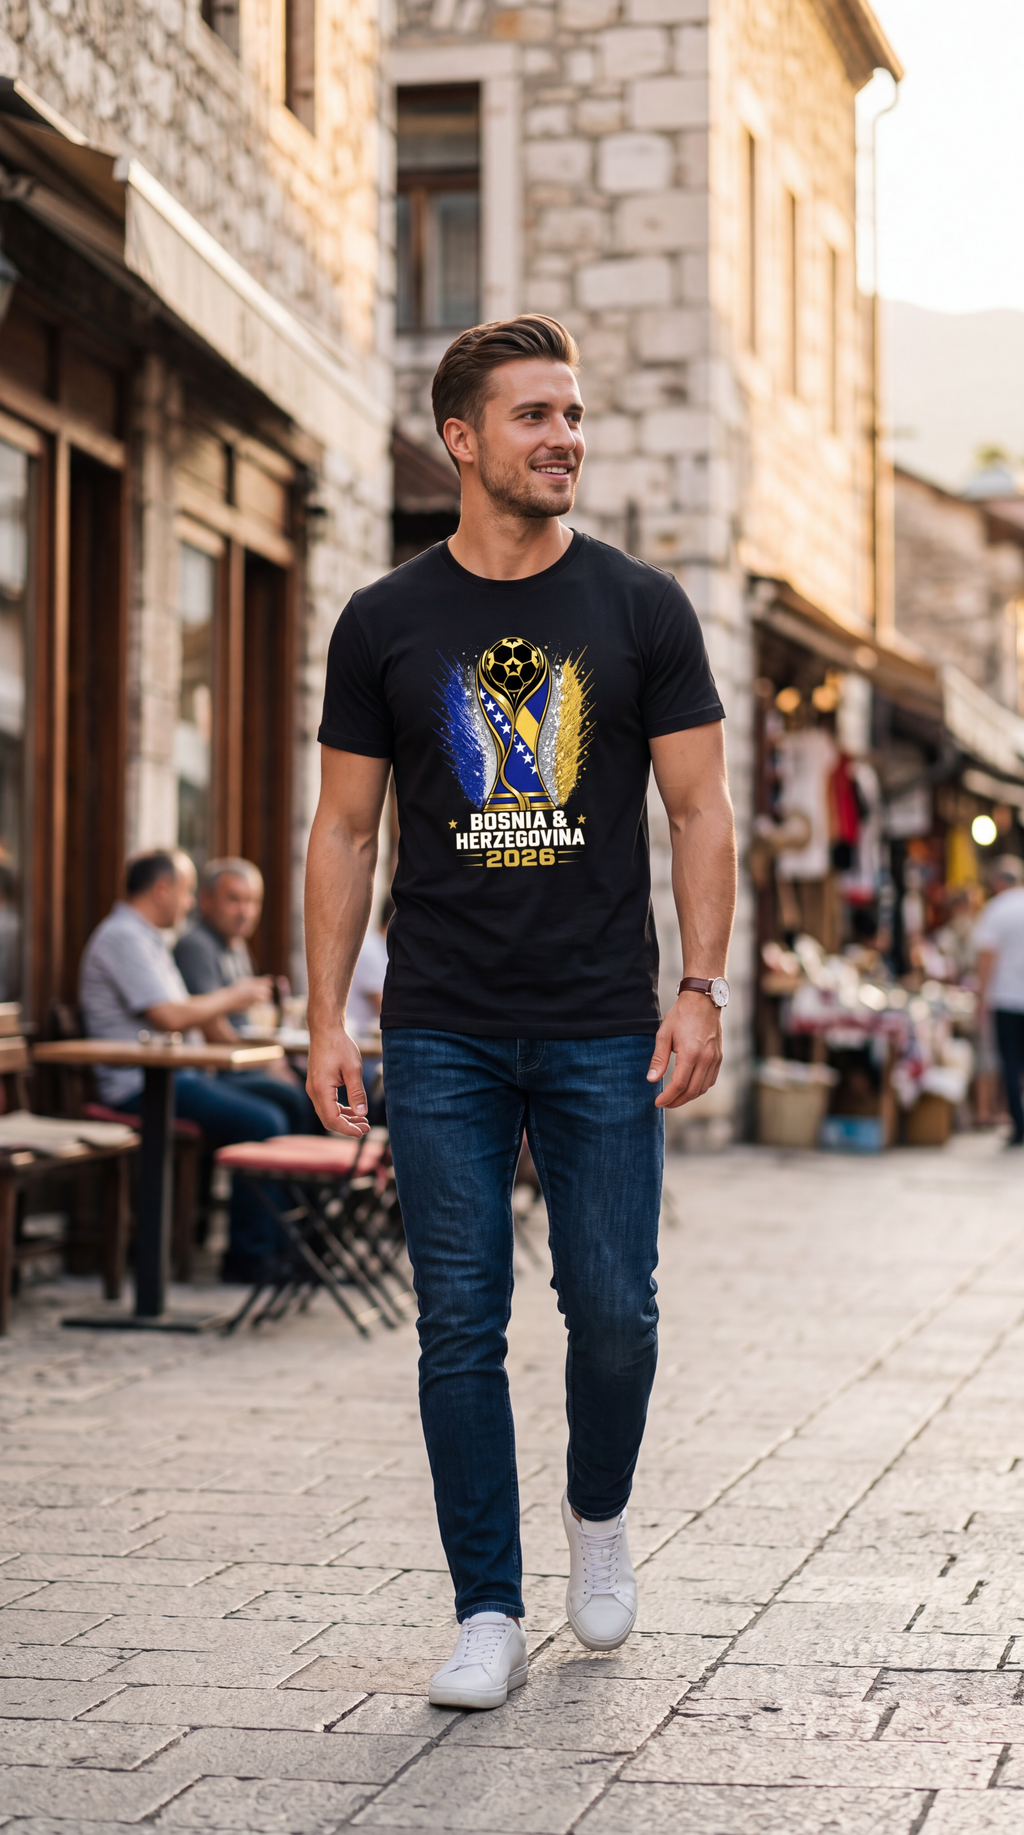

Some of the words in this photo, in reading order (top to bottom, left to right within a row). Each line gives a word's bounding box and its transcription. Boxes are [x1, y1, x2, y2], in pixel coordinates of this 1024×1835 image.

[470, 811, 547, 831] BOSNIA
[552, 810, 568, 827] &
[456, 828, 585, 849] HERZEGOVINA
[486, 848, 555, 868] 2026
